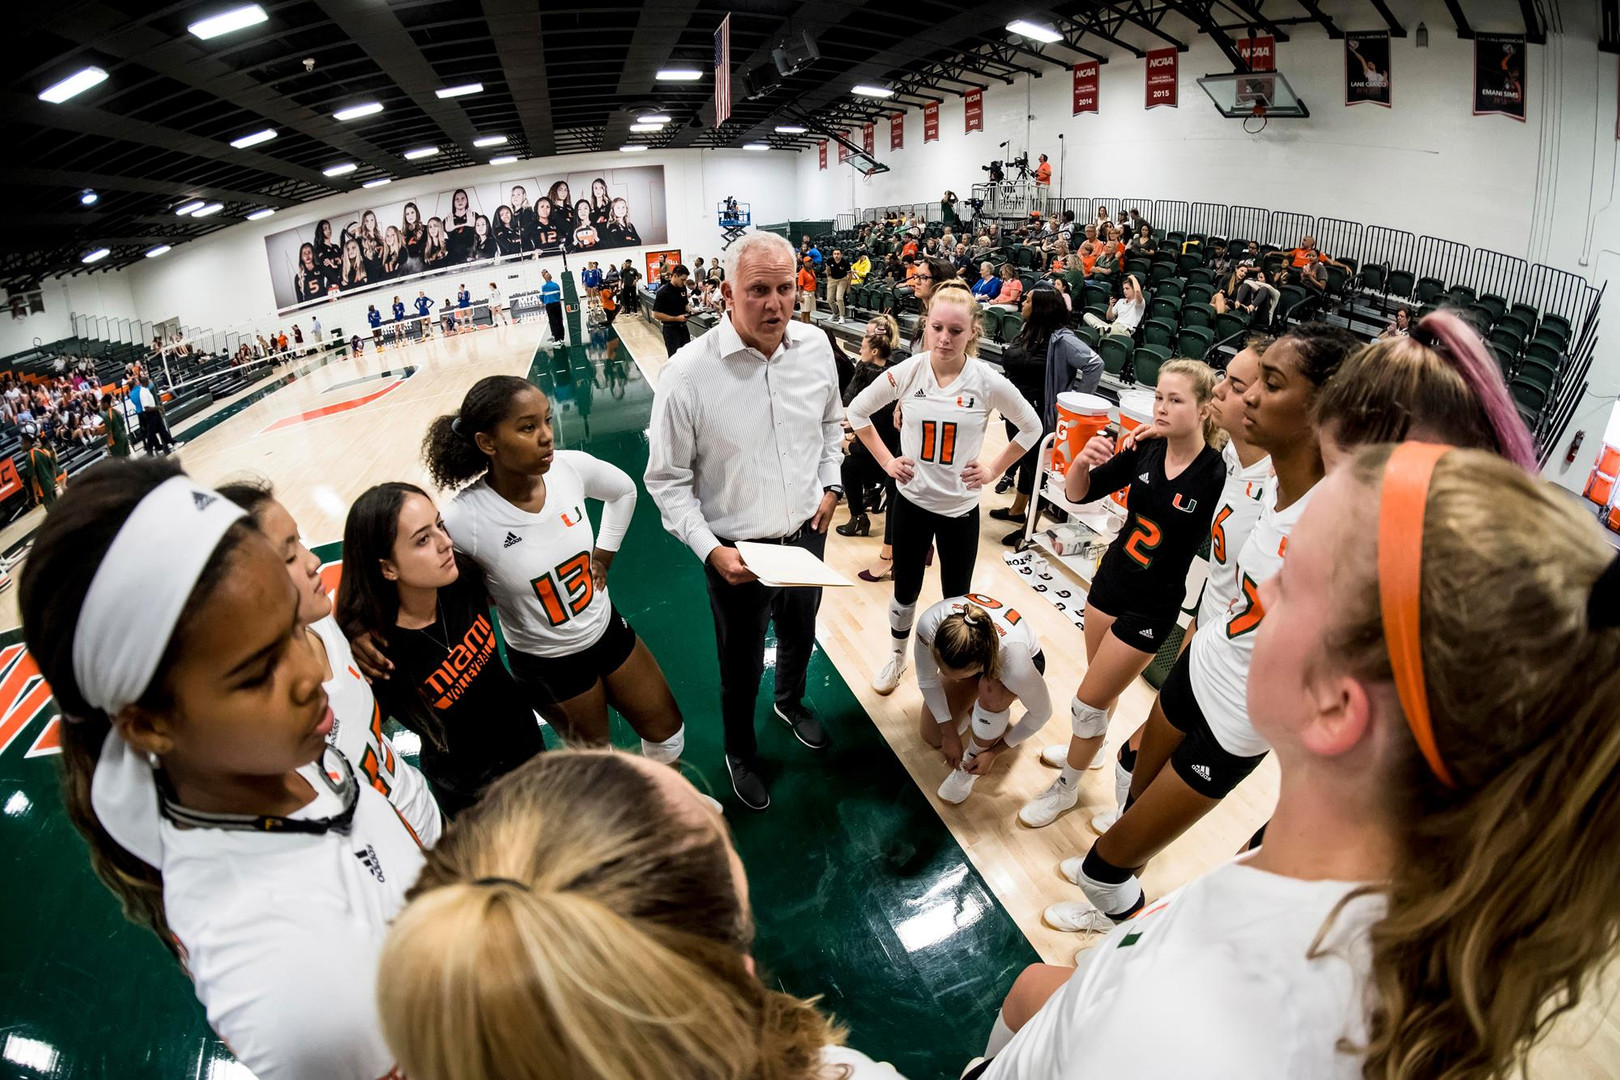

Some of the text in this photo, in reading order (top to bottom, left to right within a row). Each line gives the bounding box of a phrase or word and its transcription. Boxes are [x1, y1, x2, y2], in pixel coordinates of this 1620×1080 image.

[1149, 56, 1174, 68] NCAA
[1076, 67, 1096, 79] NCAA
[1078, 97, 1093, 106] 2014
[1153, 89, 1170, 98] 2015
[1482, 88, 1519, 99] EMANI SIMS
[539, 230, 557, 245] 12
[308, 280, 320, 294] 5
[1056, 420, 1069, 440] G
[920, 420, 958, 465] 11
[1172, 492, 1198, 514] U
[560, 506, 583, 527] U
[503, 536, 523, 549] adidas
[1123, 512, 1163, 570] 2
[1211, 503, 1234, 565] 6
[529, 550, 594, 627] 13
[424, 613, 491, 695] MIAMI
[445, 640, 493, 701] VOLLEYBALL
[1191, 764, 1212, 782] adidas
